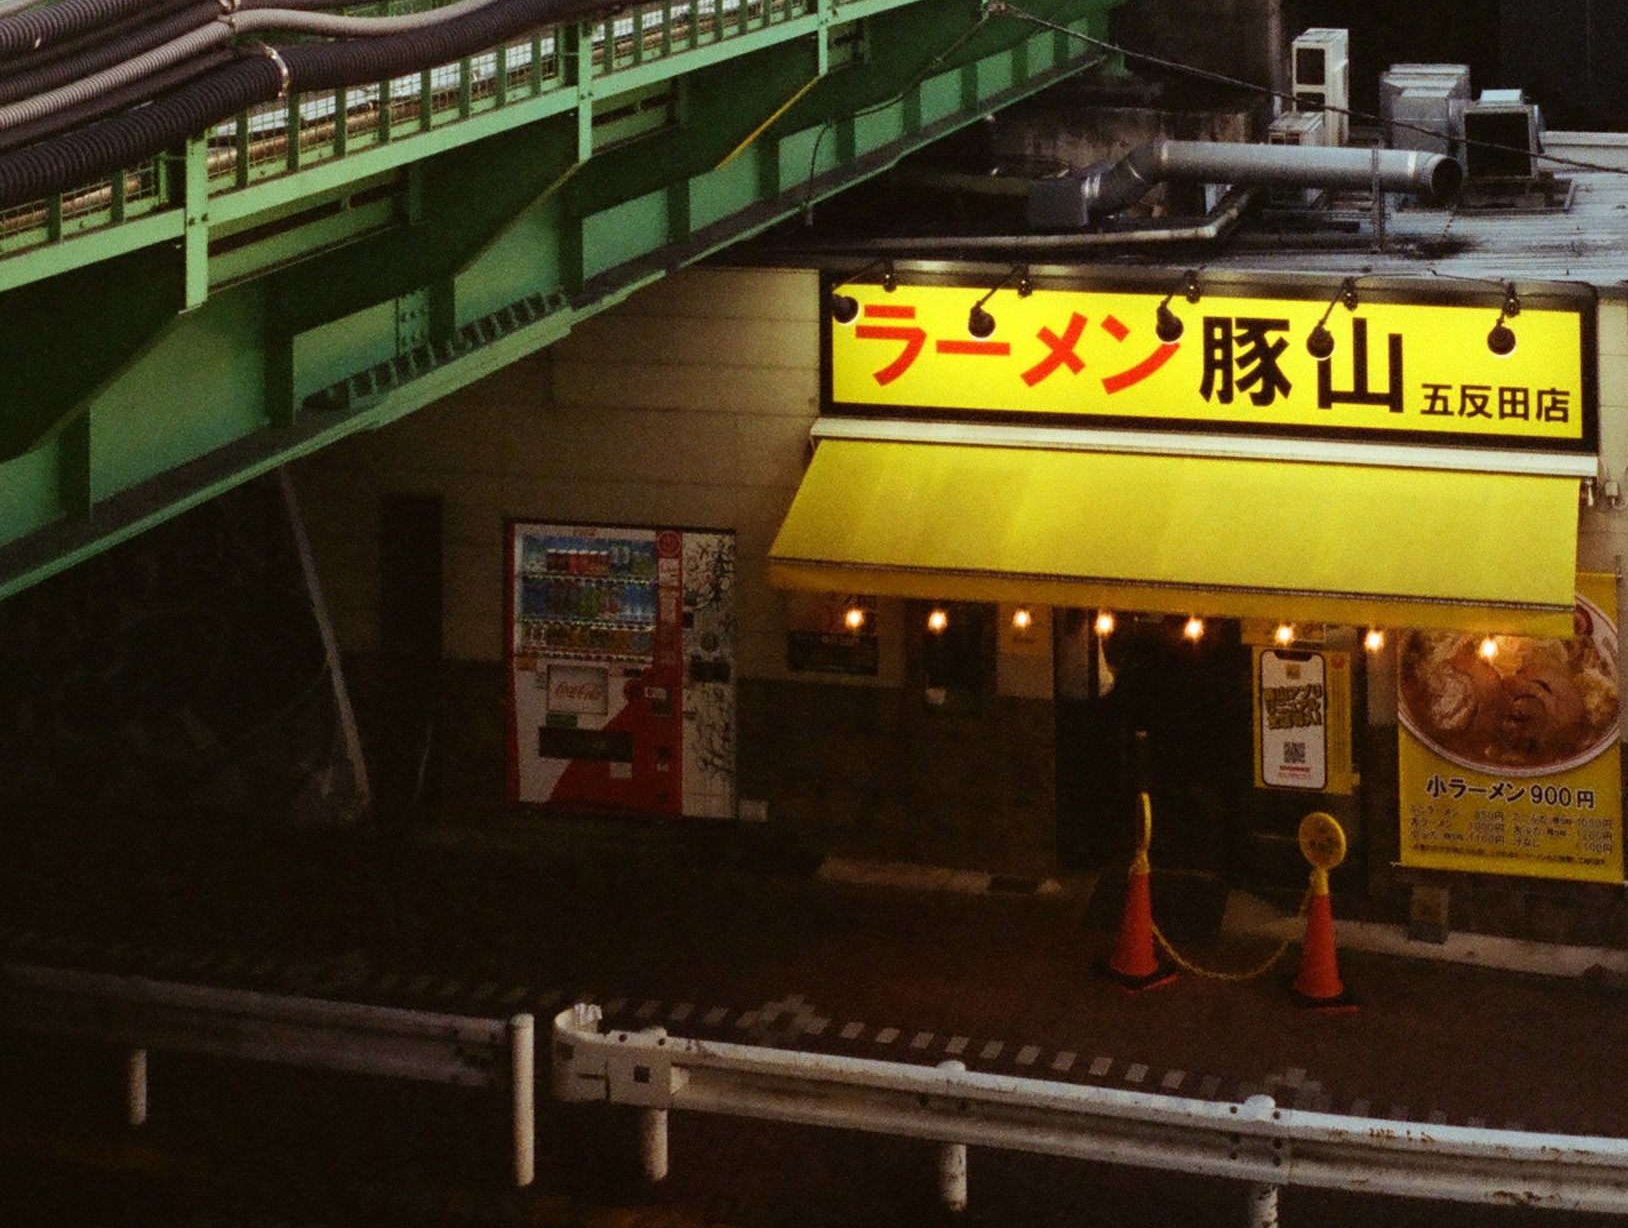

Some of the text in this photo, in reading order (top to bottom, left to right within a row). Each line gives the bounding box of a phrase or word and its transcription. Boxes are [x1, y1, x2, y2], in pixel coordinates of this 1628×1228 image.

[854, 303, 1571, 423] ラーメン 豚山 五反田店
[1530, 784, 1595, 809] 900円
